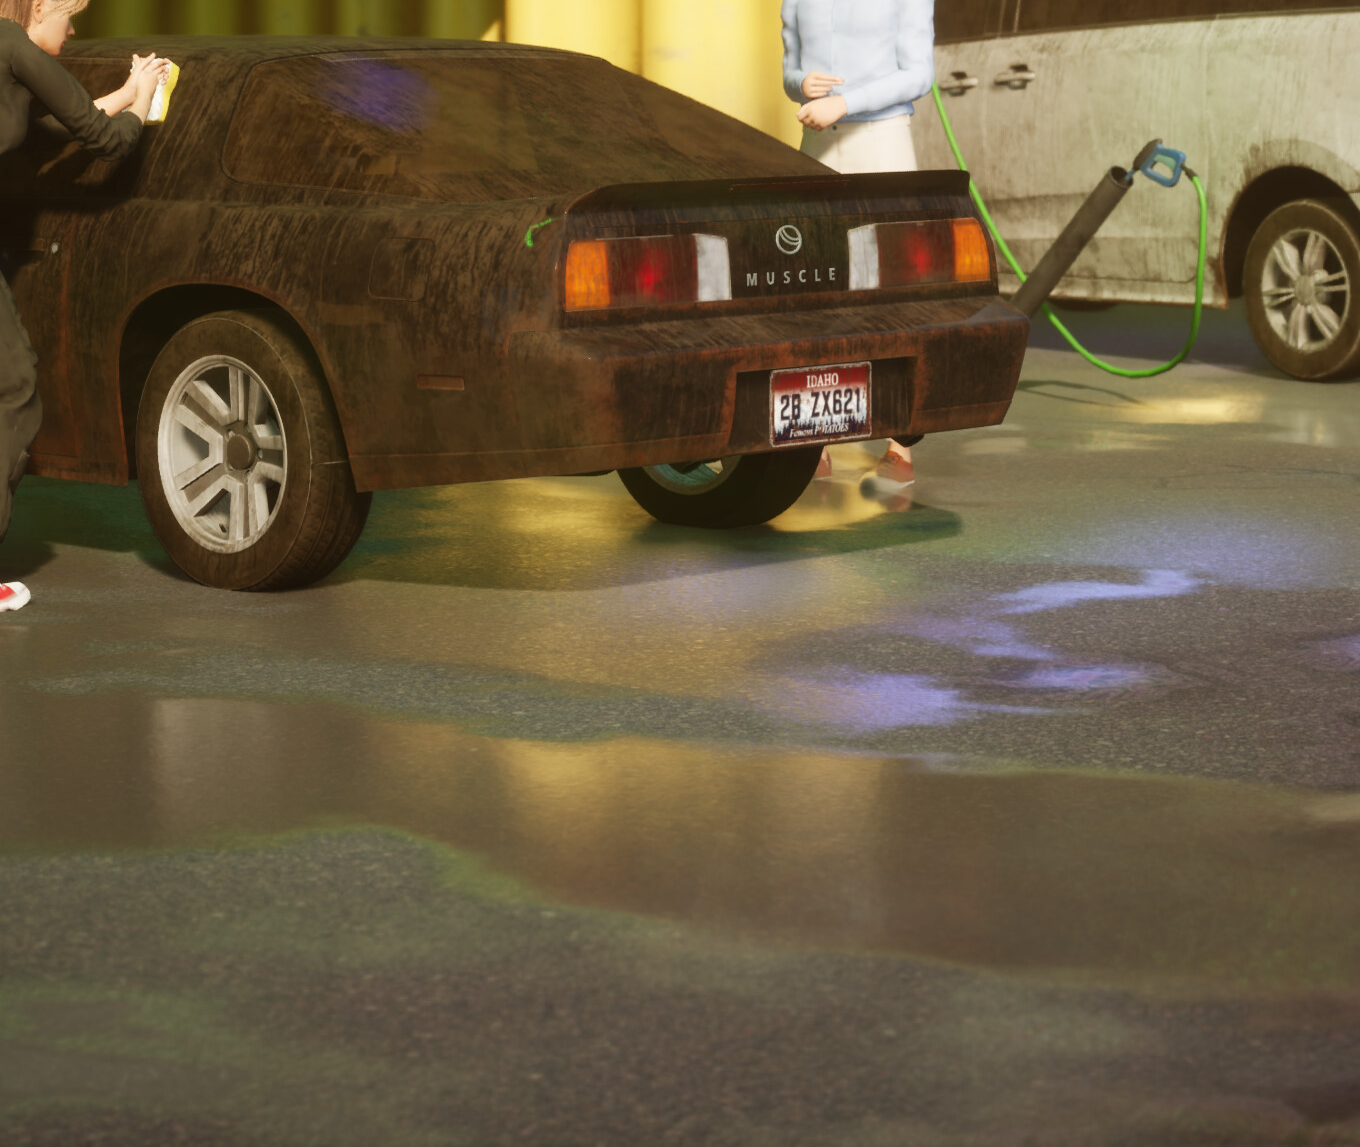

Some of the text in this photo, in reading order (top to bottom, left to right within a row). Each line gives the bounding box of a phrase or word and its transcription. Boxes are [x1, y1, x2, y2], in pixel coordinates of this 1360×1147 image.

[746, 267, 836, 287] MUSCLE
[806, 372, 839, 388] IDAHO
[780, 387, 860, 420] 2B ZX621
